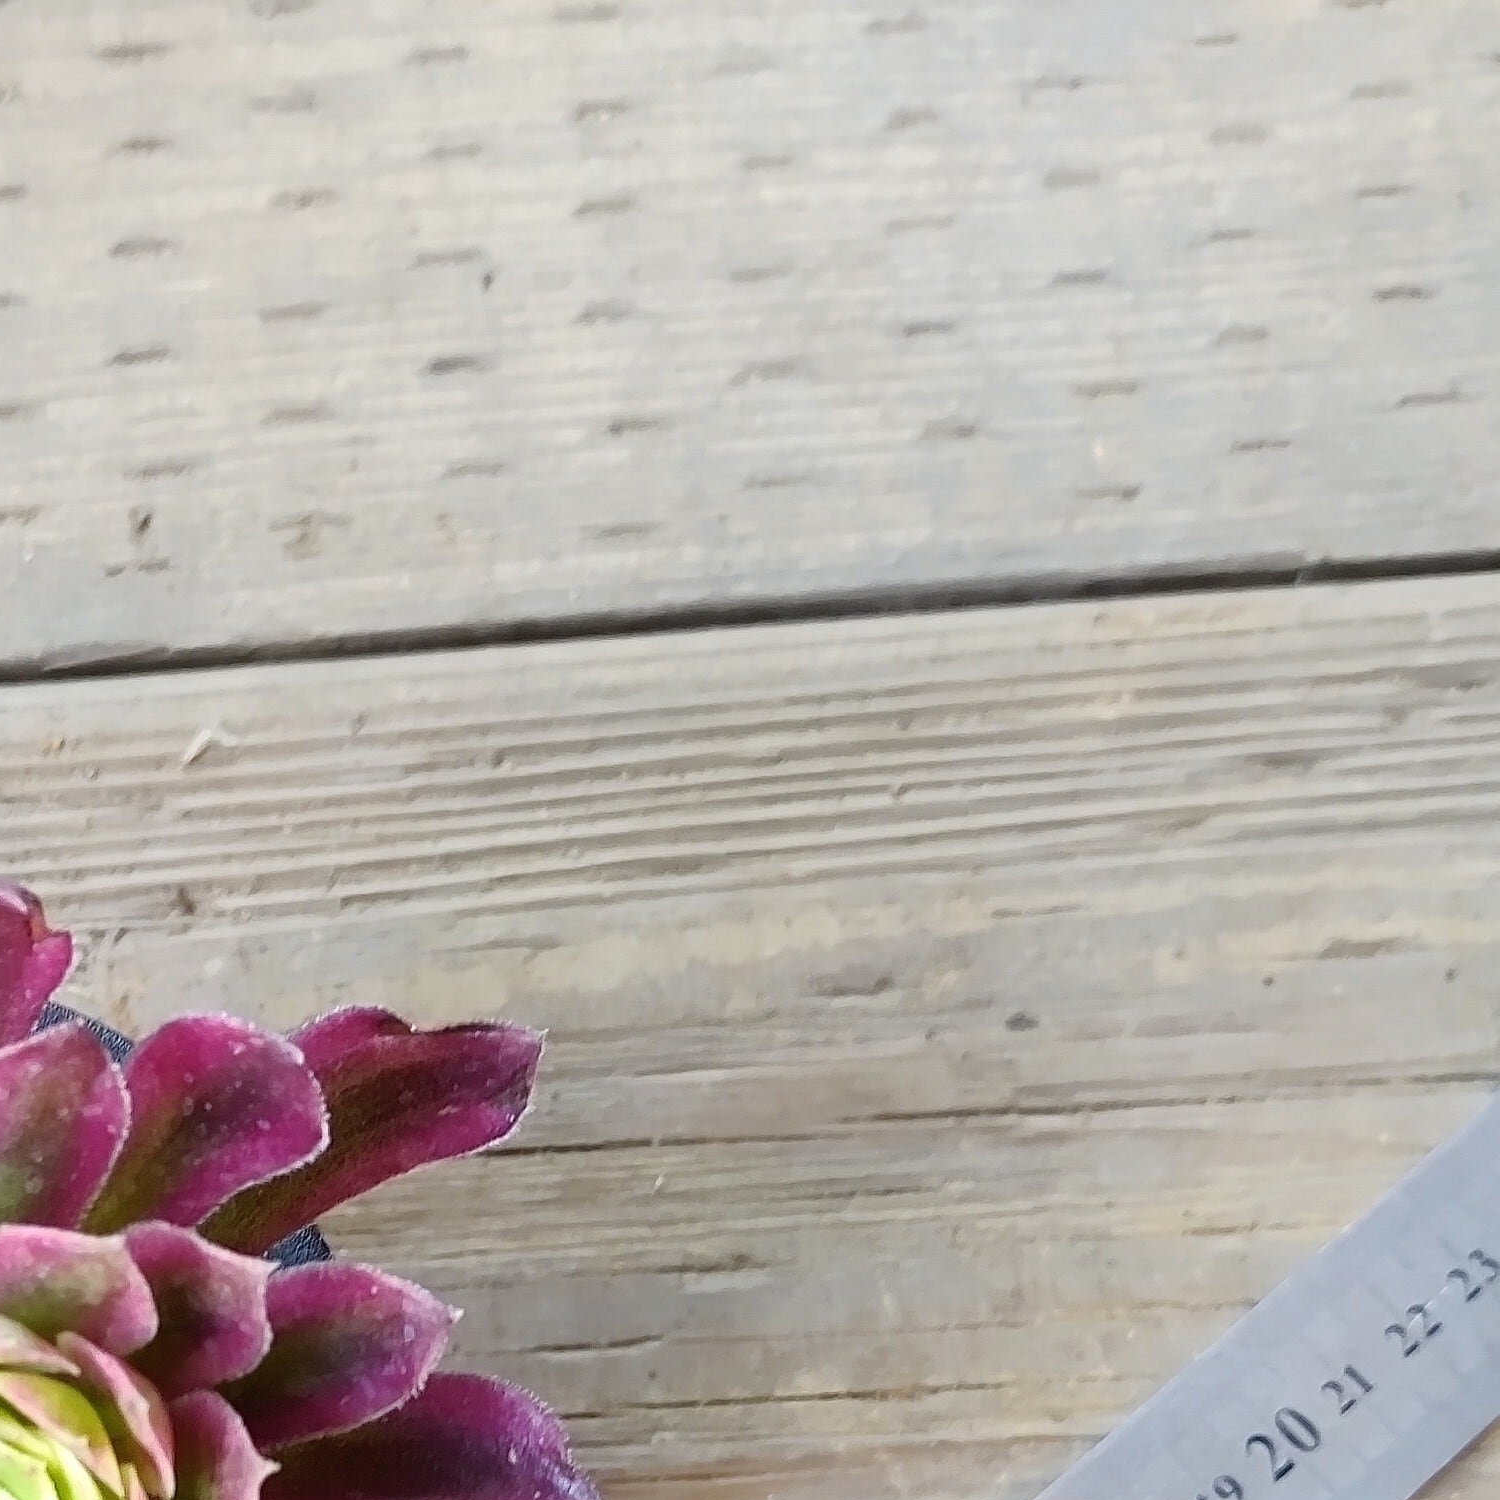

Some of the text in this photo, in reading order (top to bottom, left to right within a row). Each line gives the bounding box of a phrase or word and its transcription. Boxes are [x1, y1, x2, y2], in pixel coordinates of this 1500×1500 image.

[1246, 1407, 1322, 1482] 20
[1321, 1364, 1375, 1415] 21
[1385, 1302, 1443, 1358] 22
[1446, 1248, 1500, 1302] 23
